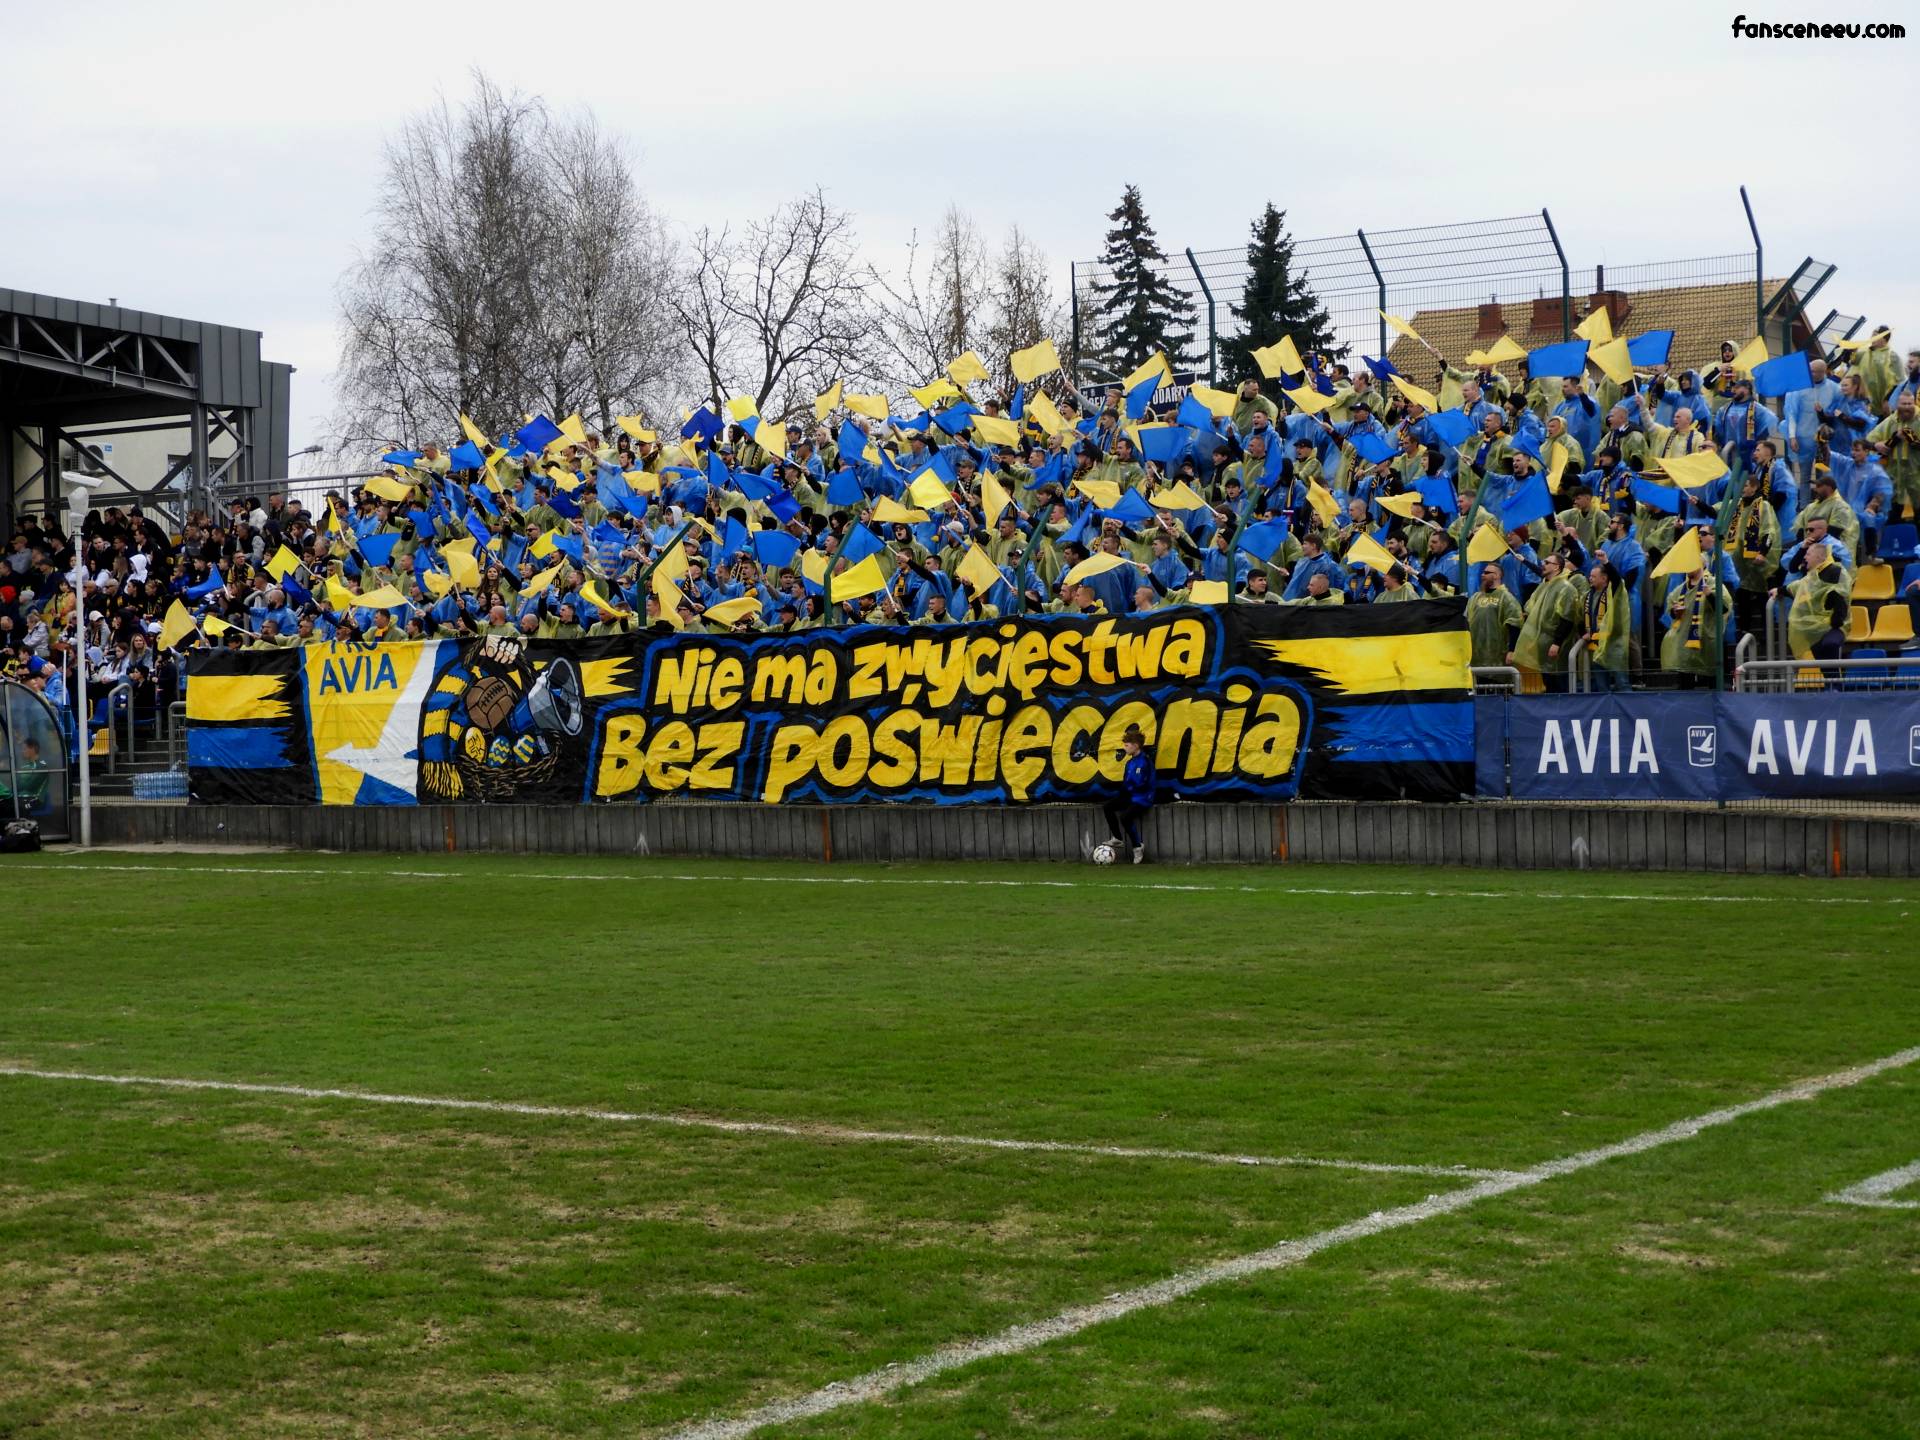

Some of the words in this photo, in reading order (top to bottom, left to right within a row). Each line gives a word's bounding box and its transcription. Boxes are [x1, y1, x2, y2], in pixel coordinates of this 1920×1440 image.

[320, 653, 398, 695] AVIA
[1538, 718, 1660, 774] AVIA
[1747, 719, 1878, 776] AVIA
